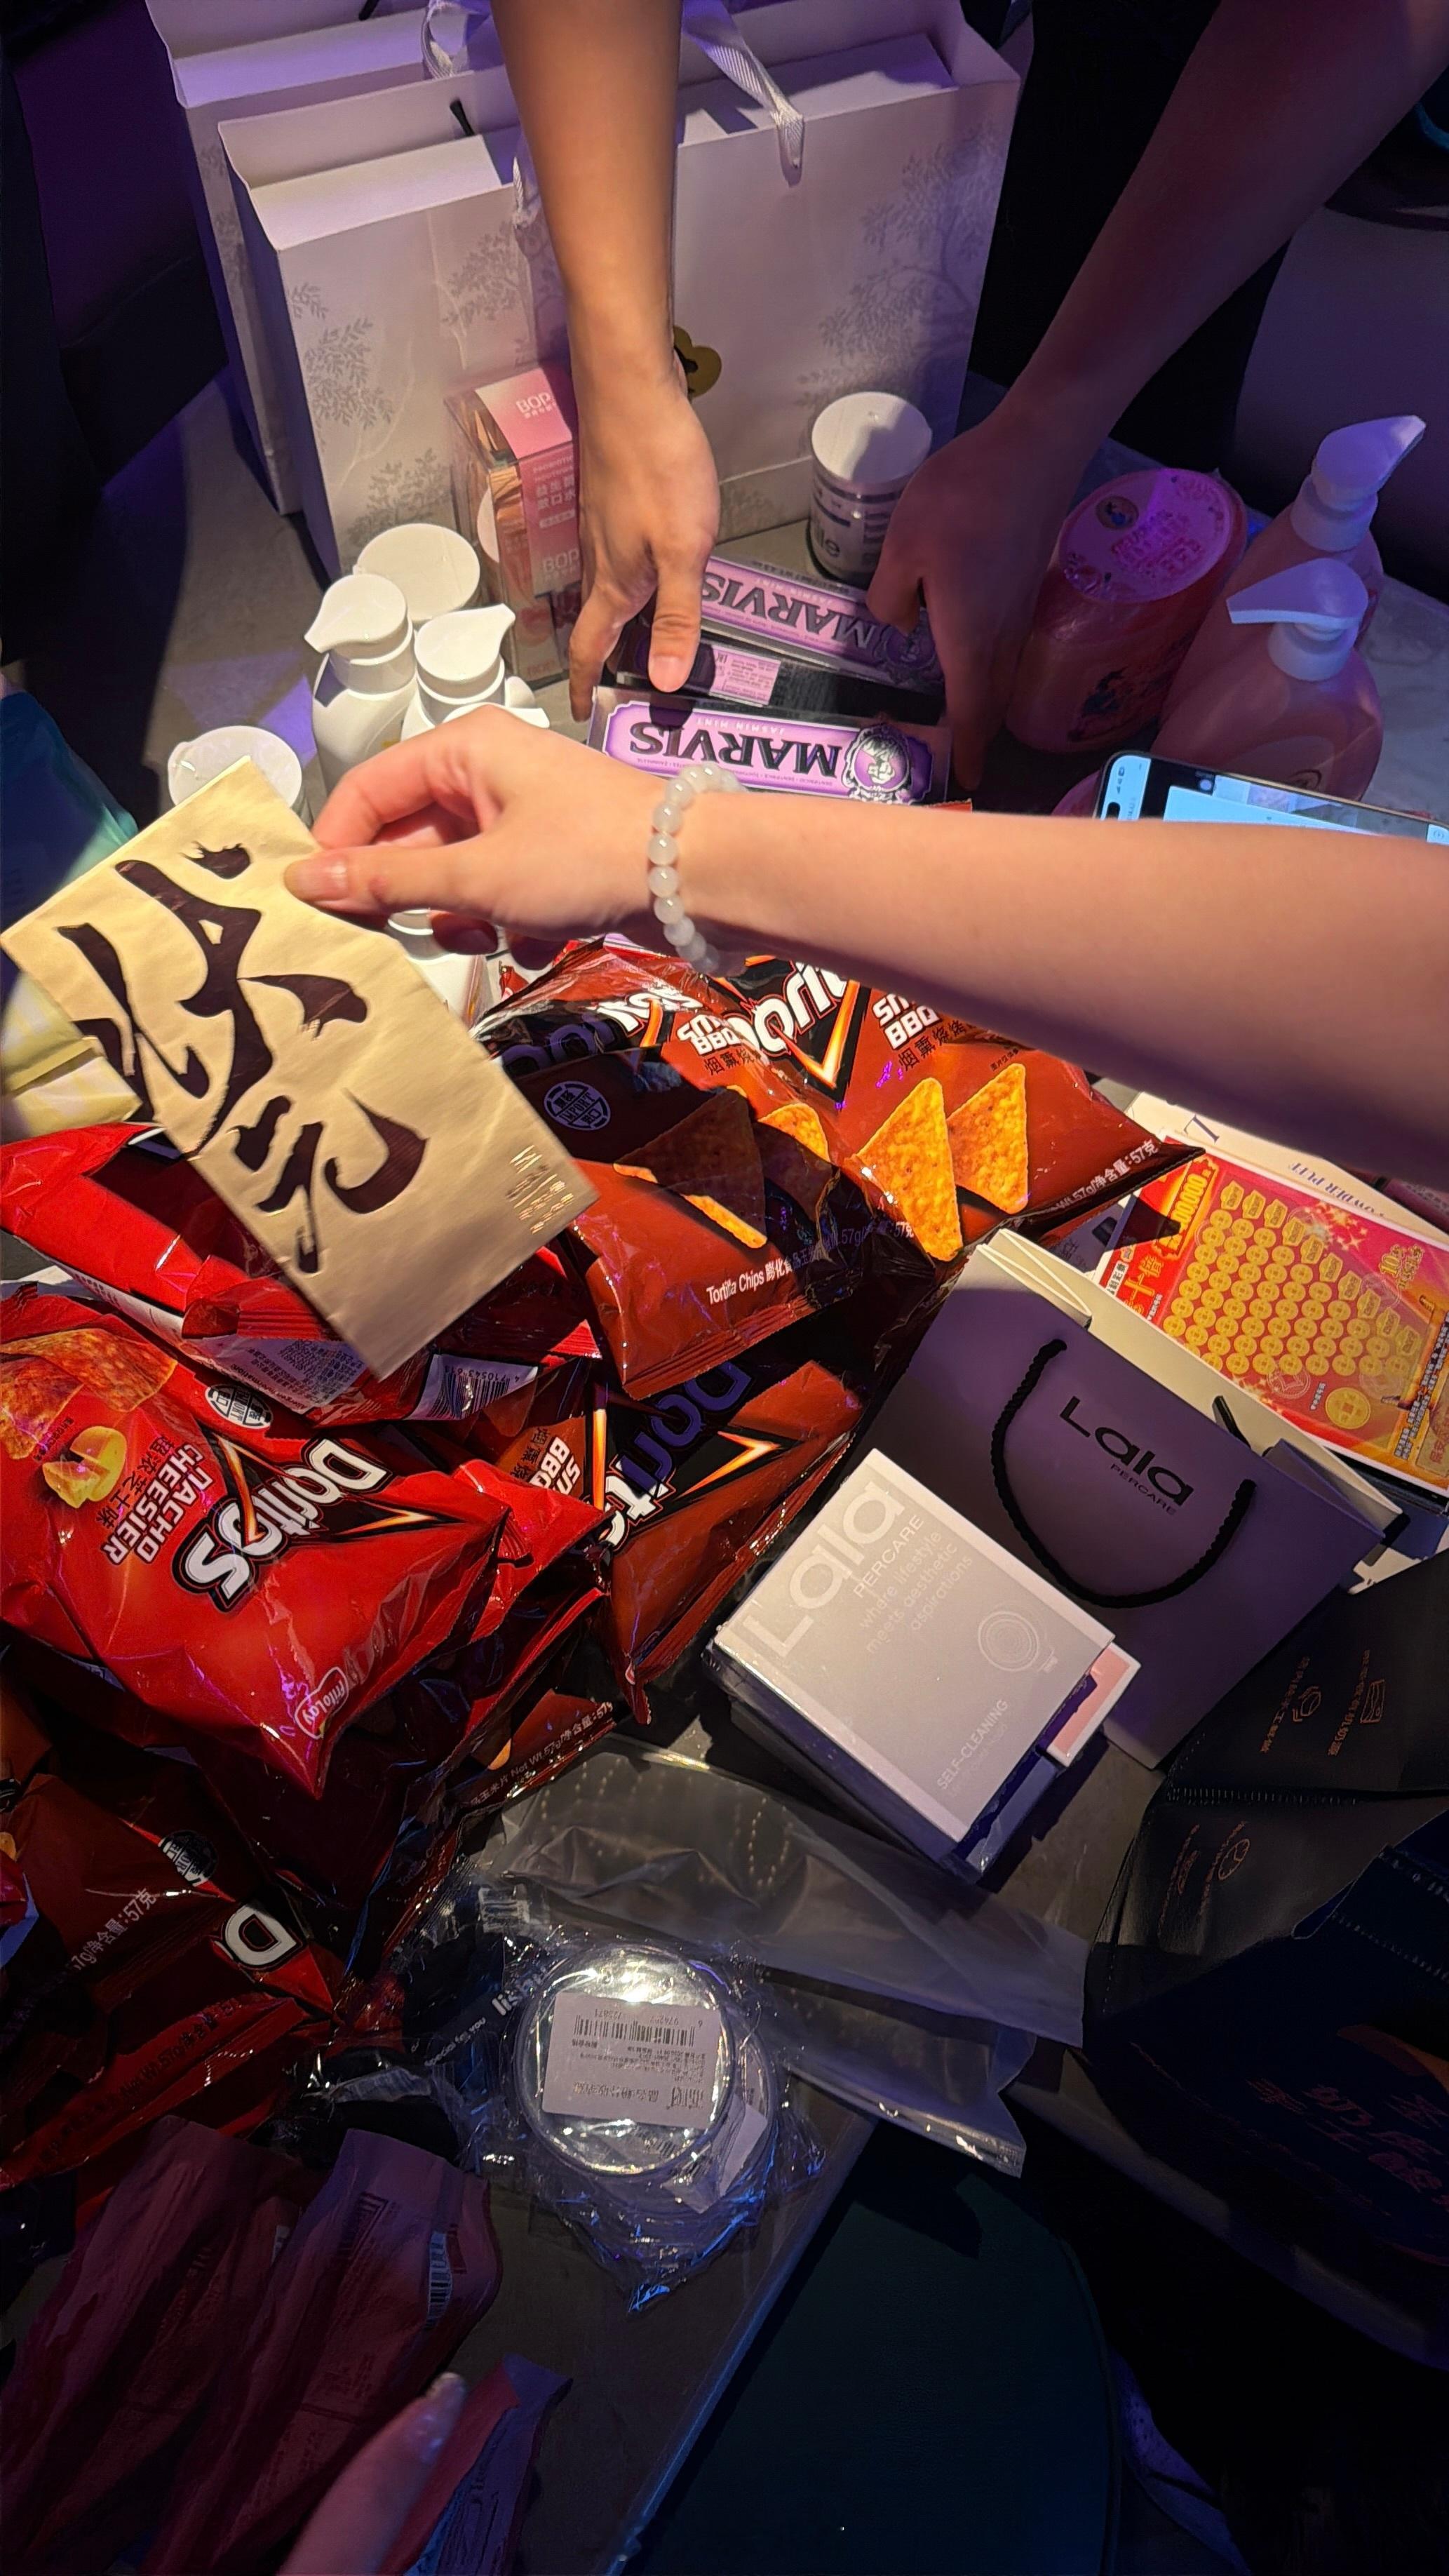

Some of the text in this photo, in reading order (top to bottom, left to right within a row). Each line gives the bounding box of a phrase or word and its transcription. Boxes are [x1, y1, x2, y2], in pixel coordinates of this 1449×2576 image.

[515, 391, 553, 415] BOP
[542, 549, 579, 572] BOP
[701, 571, 875, 648] MARVIS
[626, 720, 842, 779] MARVIS
[695, 716, 785, 735] JASMIN MINT
[884, 1006, 942, 1050] BBQ
[896, 1019, 975, 1073] 烟熏烧烤
[559, 1092, 595, 1123] IMPORT
[706, 1277, 738, 1306] Tortilla
[739, 1270, 766, 1294] Chips
[468, 1369, 506, 1381] 710543
[96, 1433, 177, 1527] 超浓芝士味
[527, 1435, 574, 1494] BBQ
[1059, 1395, 1194, 1508] Lala
[100, 1442, 202, 1566] CHEESIER
[139, 1468, 214, 1564] NACHO
[180, 1438, 388, 1599] Doritos
[1109, 1461, 1178, 1516] PERCARE
[741, 1480, 905, 1658] Lala
[853, 1514, 926, 1597] PERCARE
[856, 1527, 947, 1631] where lifestyle
[863, 1540, 960, 1656] meets aesthetic
[904, 1552, 976, 1633] aspirations
[508, 1762, 529, 1778] Net
[936, 1698, 1010, 1790] SELF-CLEANING
[69, 1886, 159, 1973] 7g/净含量:57克
[467, 2015, 488, 2035] you
